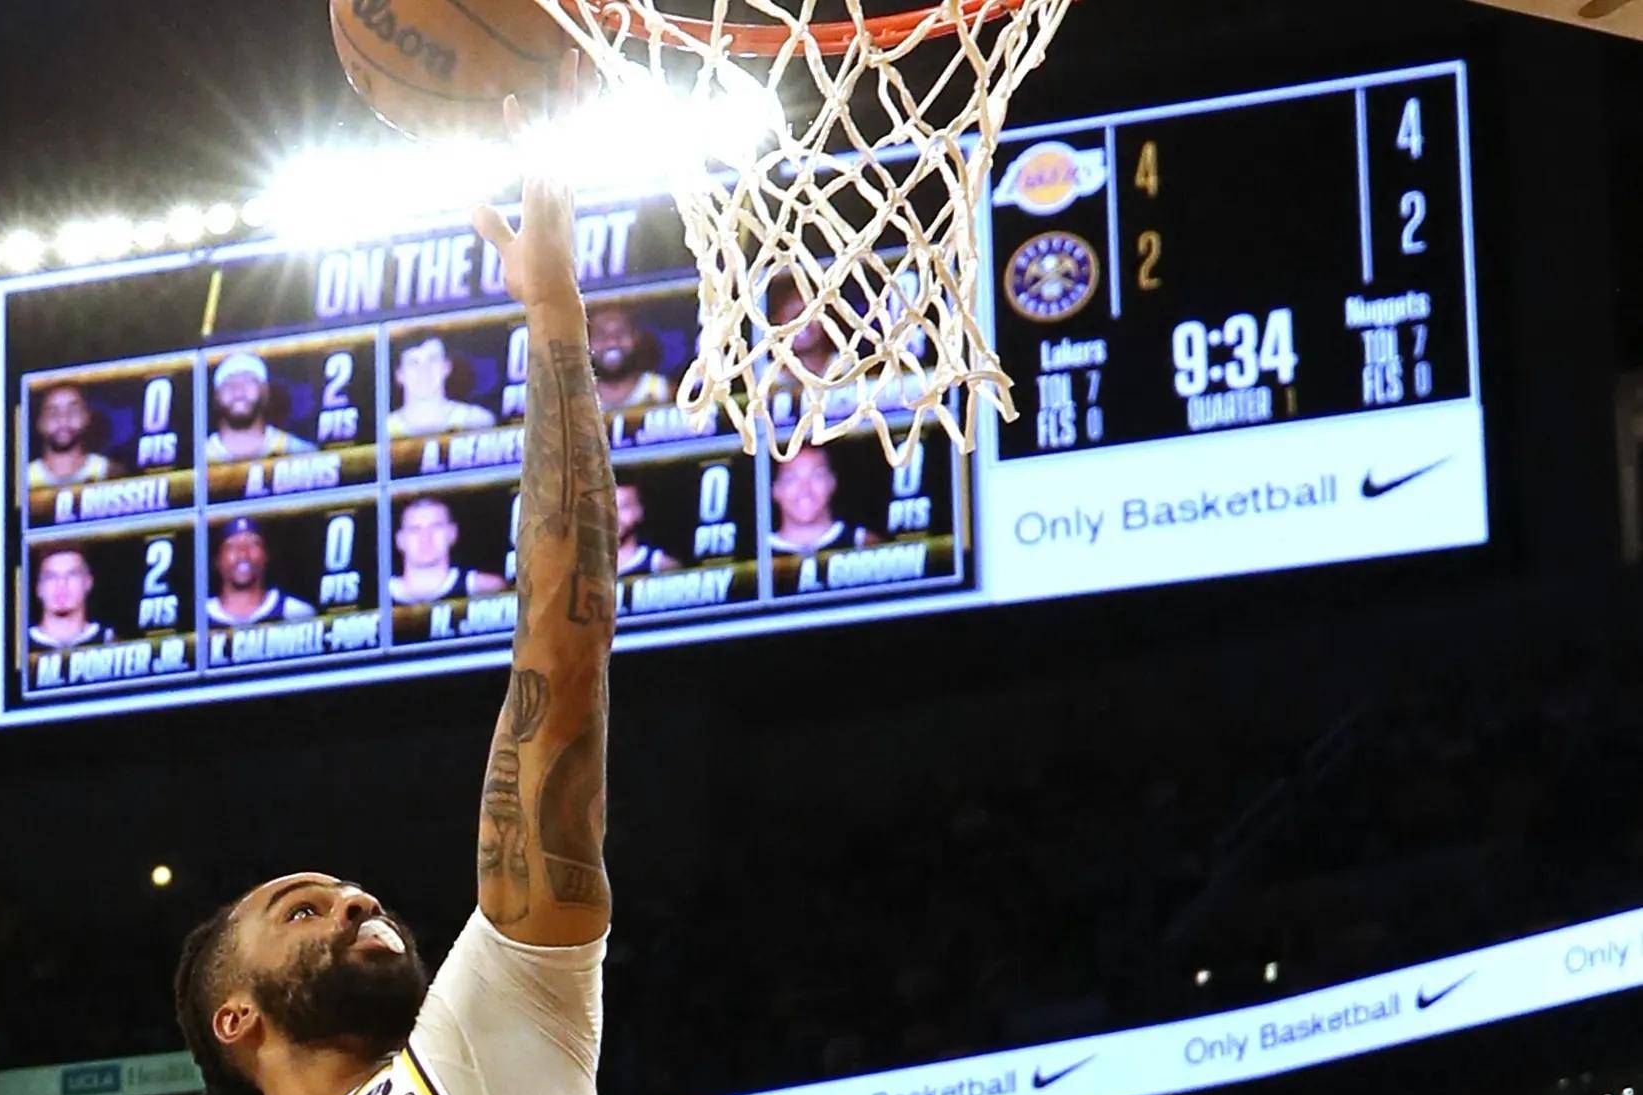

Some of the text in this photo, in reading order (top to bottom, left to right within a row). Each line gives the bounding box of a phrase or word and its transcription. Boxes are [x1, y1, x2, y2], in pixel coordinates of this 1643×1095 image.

[1395, 97, 1425, 160] 4
[1134, 139, 1159, 196] 4
[1400, 191, 1428, 254] 2
[314, 247, 385, 320] ON
[394, 234, 474, 307] THE
[1136, 231, 1162, 291] 2
[1171, 308, 1300, 399] 9:34
[1413, 324, 1429, 360] 7
[141, 377, 174, 436] 0
[322, 351, 356, 411] 2
[1086, 369, 1102, 405] 7
[698, 464, 732, 524] 0
[1012, 473, 1340, 548] Only Basketball
[142, 539, 174, 596] 2
[325, 514, 355, 573] 0
[1183, 993, 1402, 1067] Only Basketball
